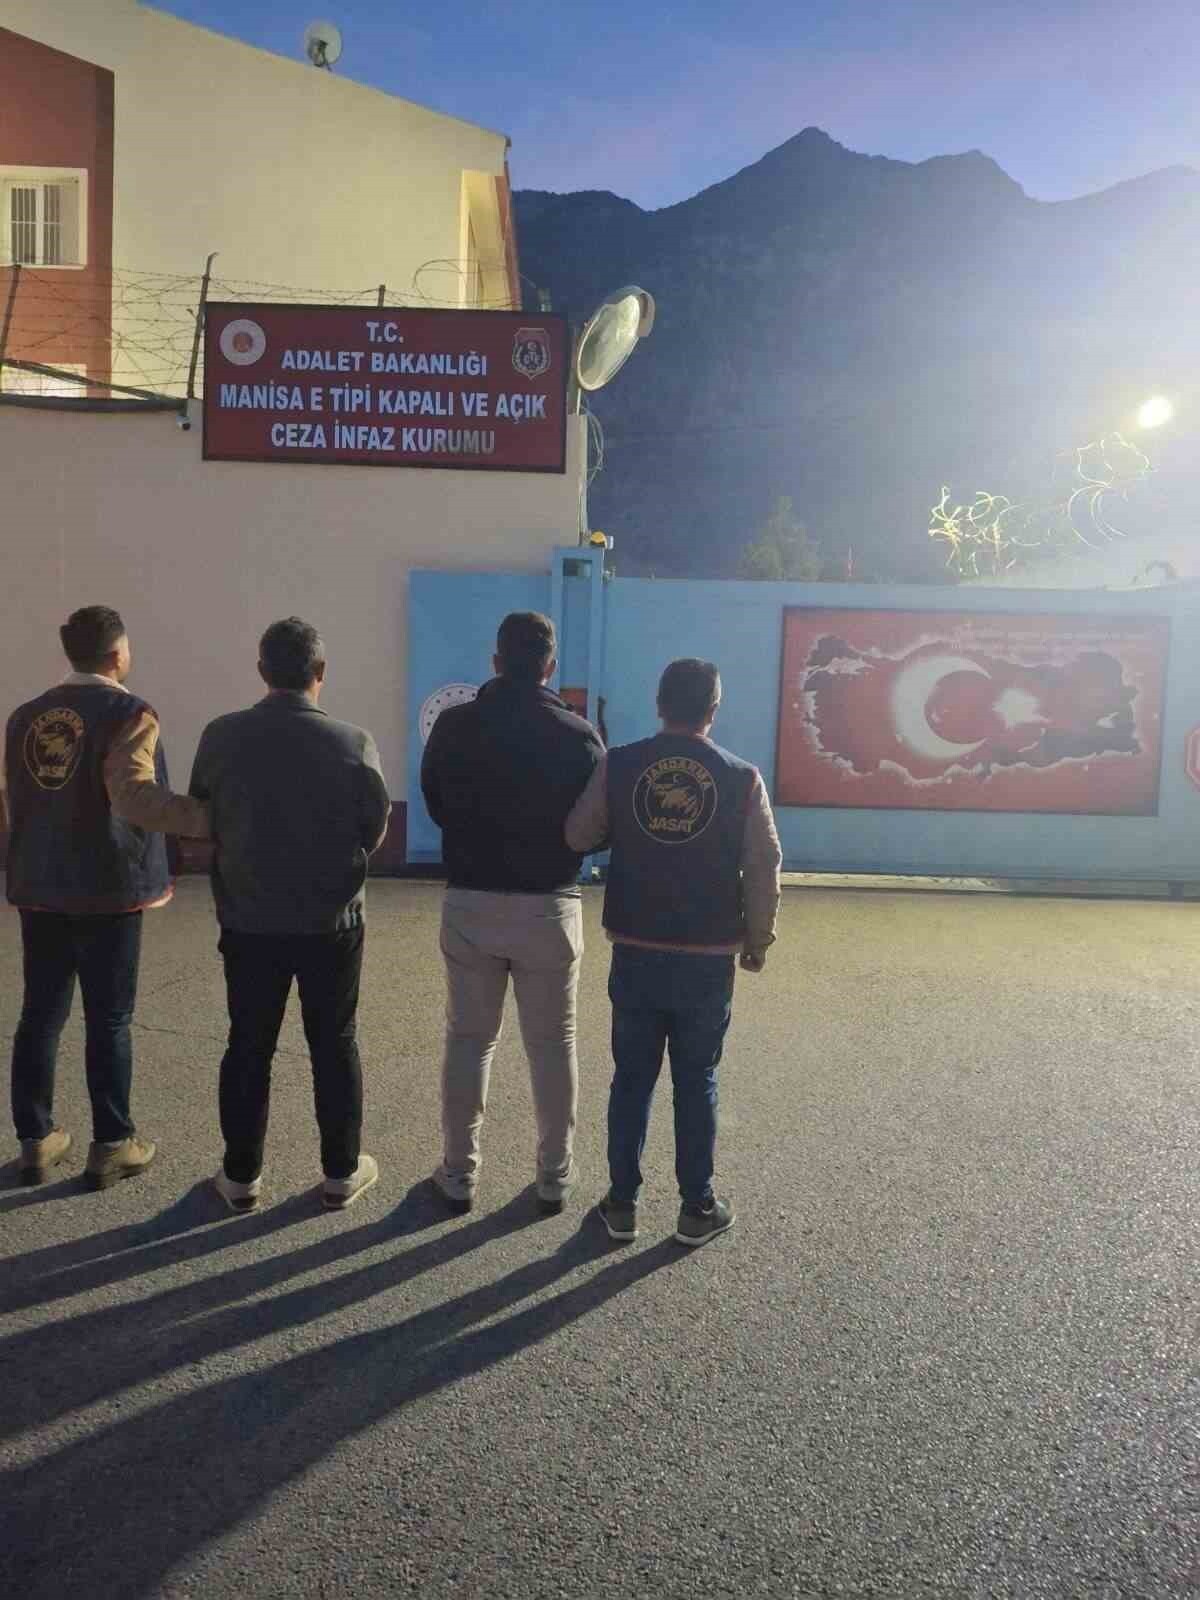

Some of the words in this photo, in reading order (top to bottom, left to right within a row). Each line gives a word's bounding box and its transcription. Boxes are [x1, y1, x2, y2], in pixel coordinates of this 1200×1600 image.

[366, 321, 404, 343] T.C.
[281, 350, 364, 371] ADALET
[371, 350, 487, 376] BAKANLIĞI
[220, 380, 304, 410] MANİSA
[310, 387, 322, 411] E
[329, 382, 371, 413] TİPİ
[379, 389, 453, 416] KAPALI
[461, 393, 489, 417] VE
[495, 393, 547, 424] AÇIK
[271, 422, 326, 448] CEZA
[334, 419, 395, 450] İNFAZ
[402, 427, 495, 454] KURUMU
